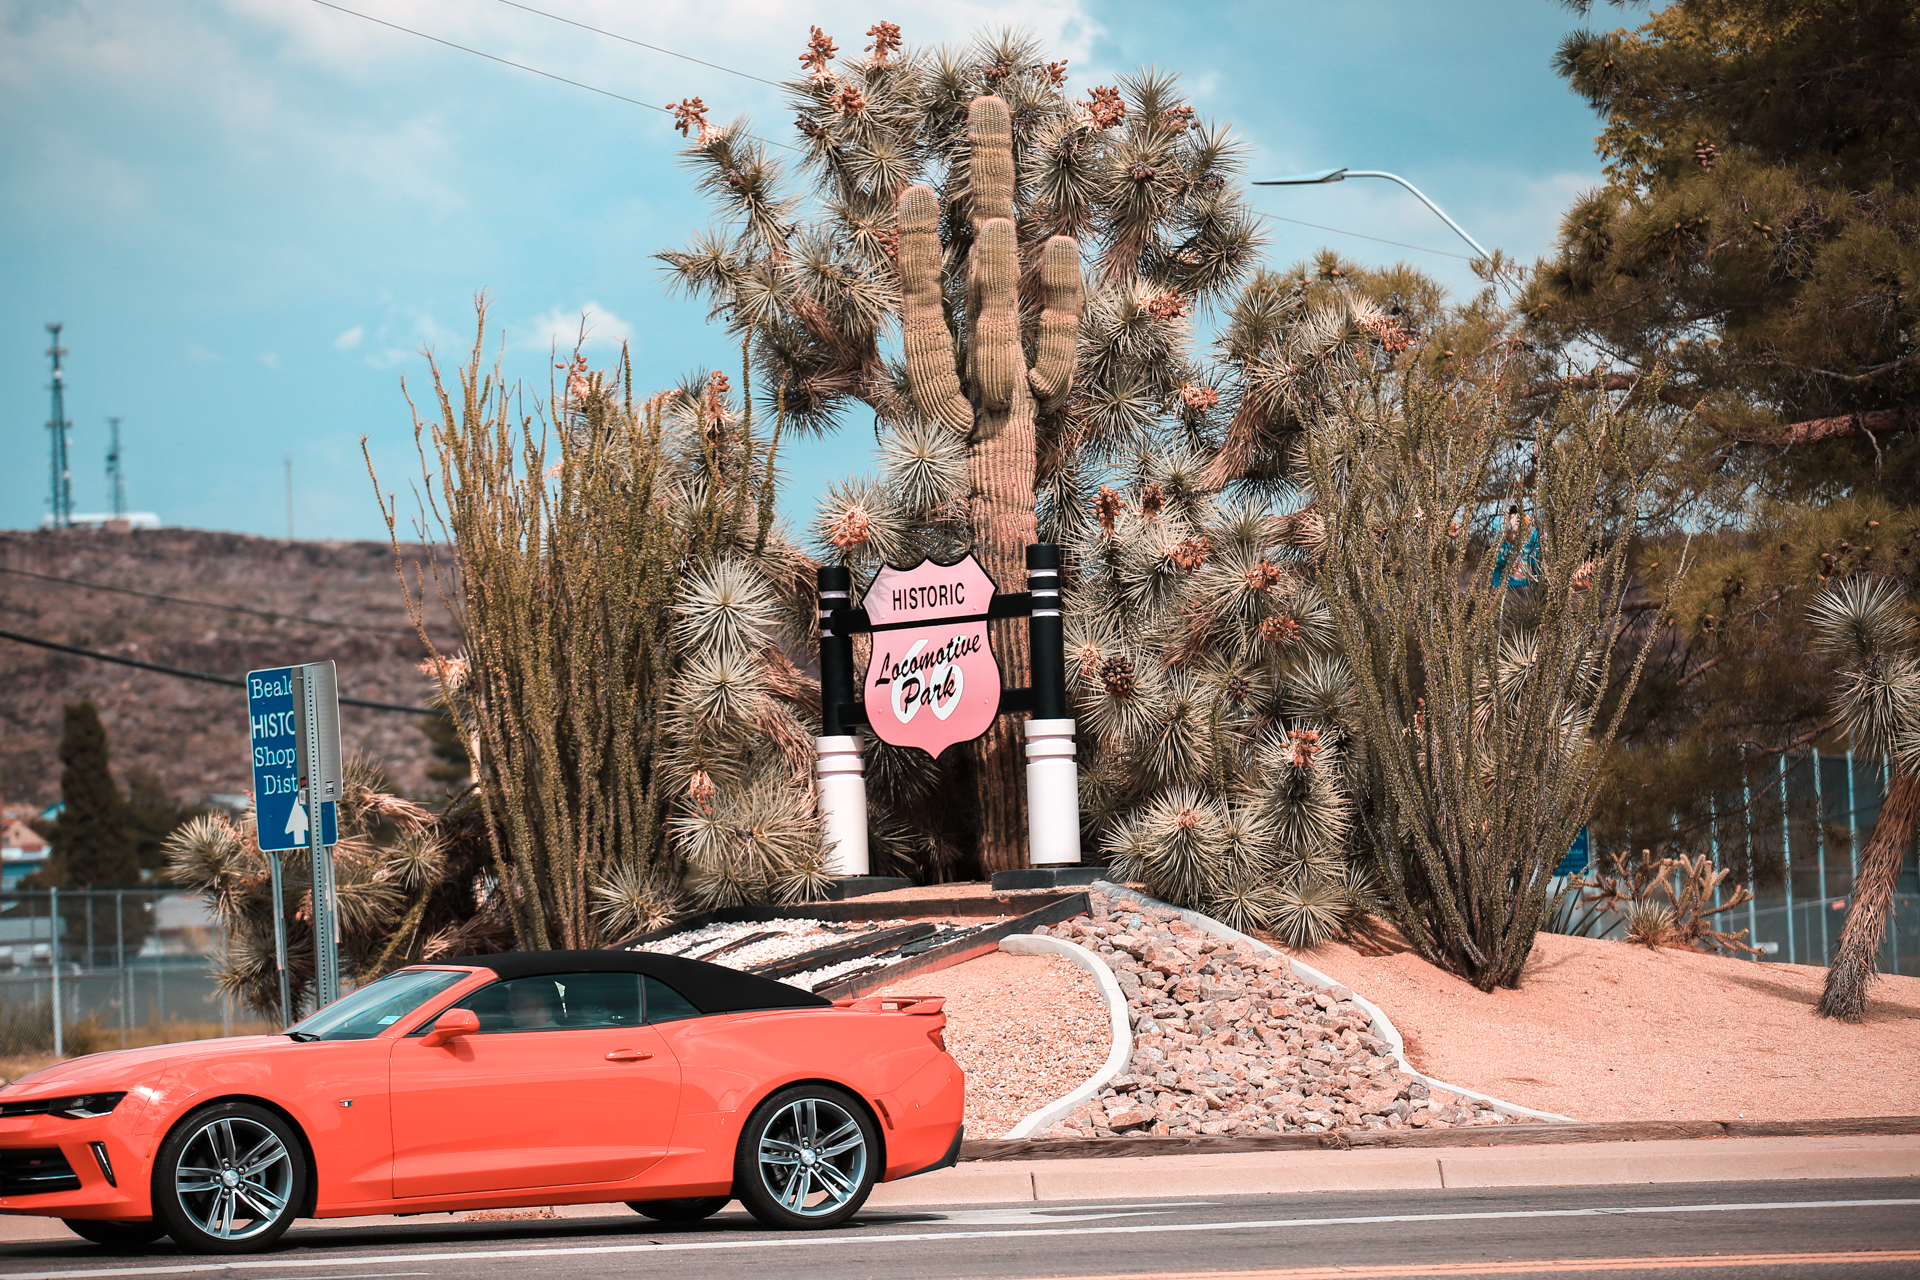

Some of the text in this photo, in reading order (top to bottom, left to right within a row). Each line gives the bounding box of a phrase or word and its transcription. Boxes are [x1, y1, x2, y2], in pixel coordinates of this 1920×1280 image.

[892, 582, 965, 611] HISTORIC
[875, 634, 982, 688] Locomotive
[891, 635, 967, 724] 66
[901, 666, 957, 714] Park
[254, 746, 297, 769] Shop
